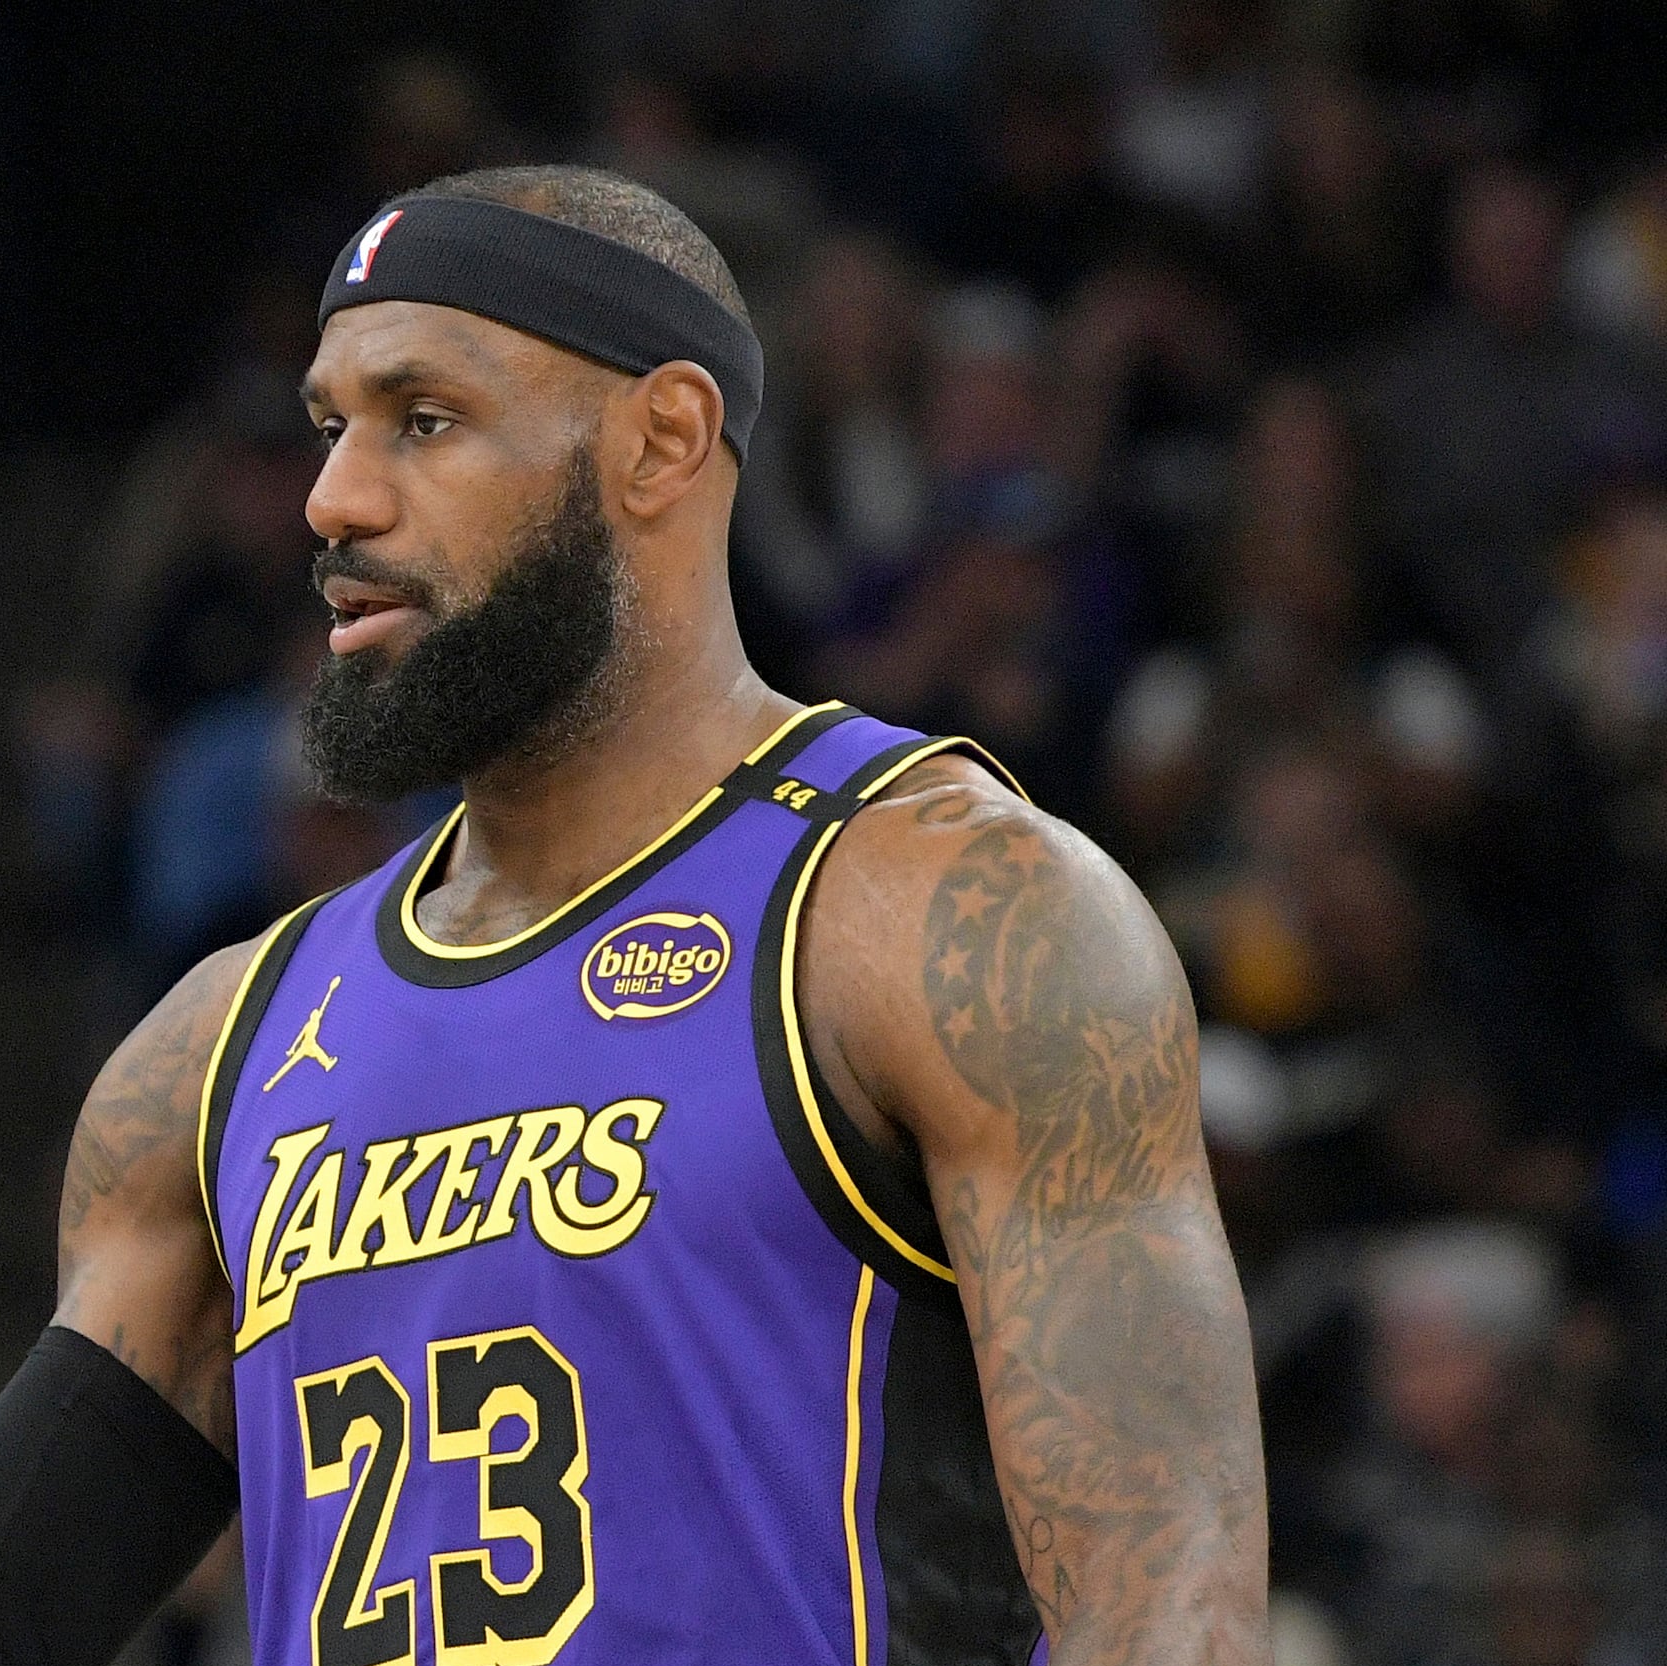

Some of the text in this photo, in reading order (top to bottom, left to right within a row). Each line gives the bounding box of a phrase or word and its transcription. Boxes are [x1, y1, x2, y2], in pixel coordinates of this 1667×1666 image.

[771, 779, 818, 811] 44
[596, 939, 722, 986] bibigo
[613, 976, 665, 996] 비비고
[230, 1096, 666, 1359] LAKERS
